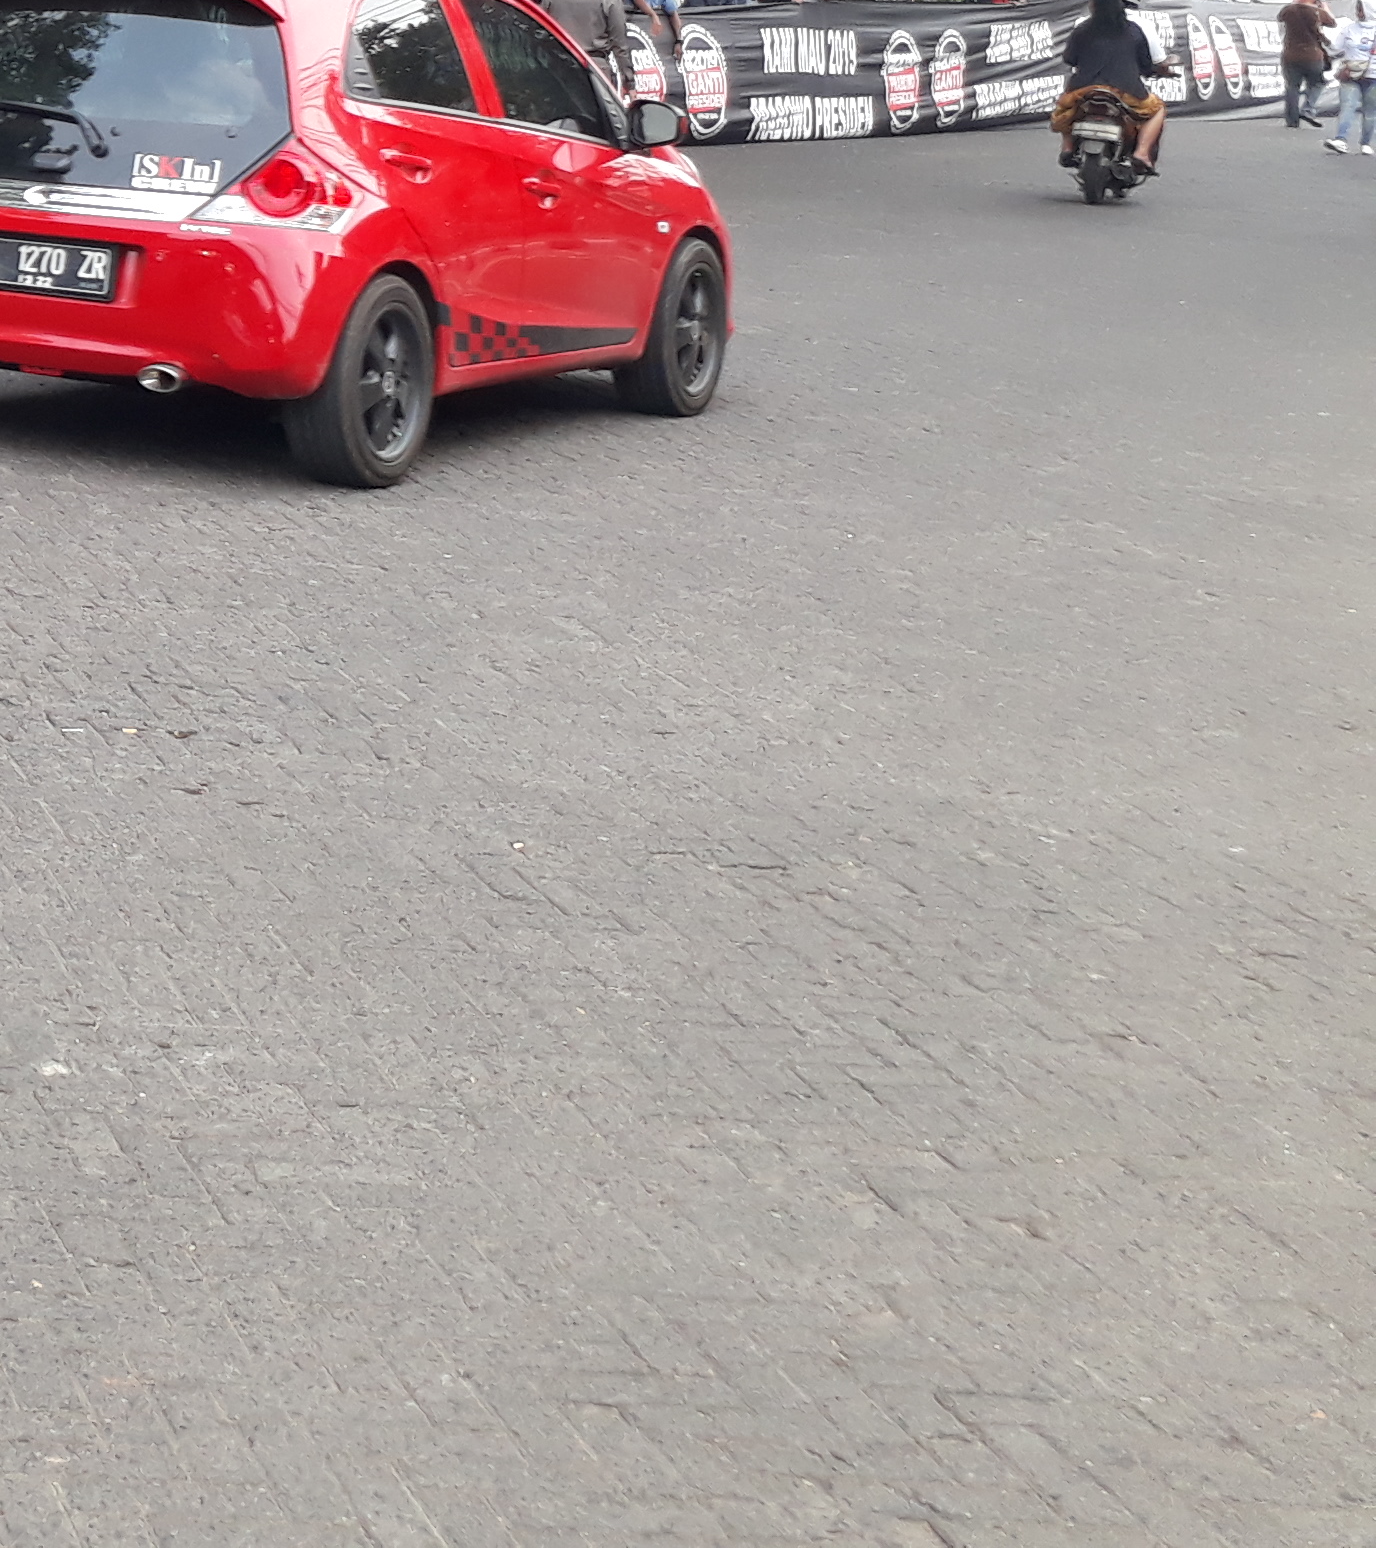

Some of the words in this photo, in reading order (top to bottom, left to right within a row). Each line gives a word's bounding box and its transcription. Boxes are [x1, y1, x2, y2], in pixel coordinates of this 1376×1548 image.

[759, 27, 796, 74] KAMI
[797, 27, 826, 76] MAU
[826, 29, 858, 76] 2019
[688, 71, 725, 95] GANTI
[813, 95, 874, 140] PRESIDEN
[17, 244, 67, 276] 1270
[76, 250, 108, 280] ZR
